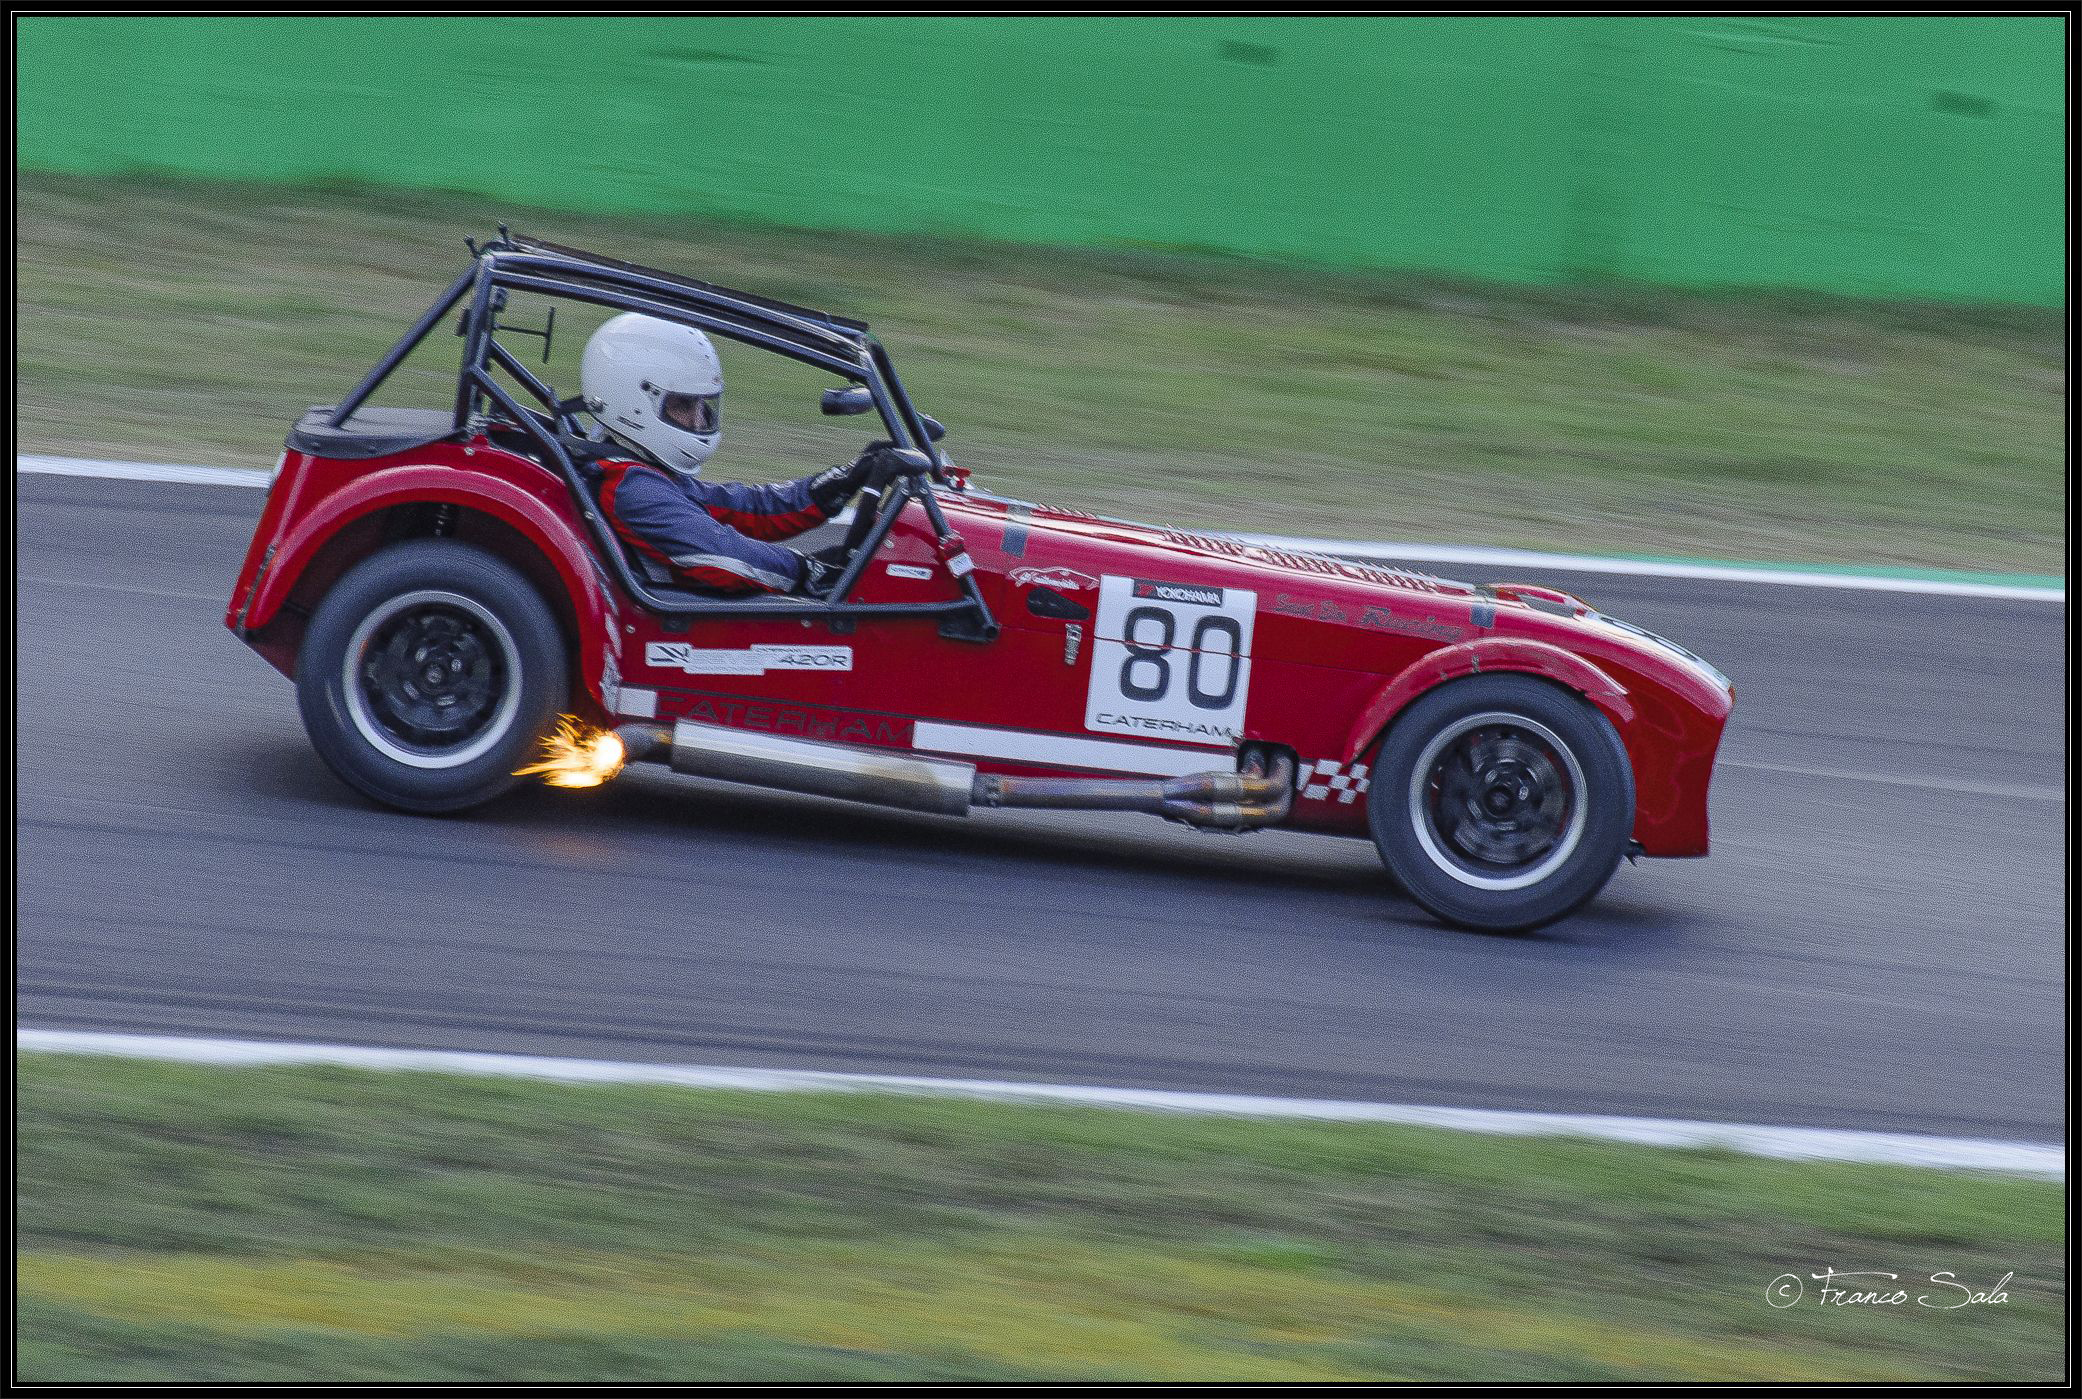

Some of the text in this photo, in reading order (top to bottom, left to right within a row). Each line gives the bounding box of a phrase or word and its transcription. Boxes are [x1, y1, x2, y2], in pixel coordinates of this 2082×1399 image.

[1155, 585, 1221, 604] YOKOHAMA
[1119, 605, 1242, 710] 80
[655, 695, 915, 743] CATERHAM
[1096, 712, 1234, 738] CATERHAM
